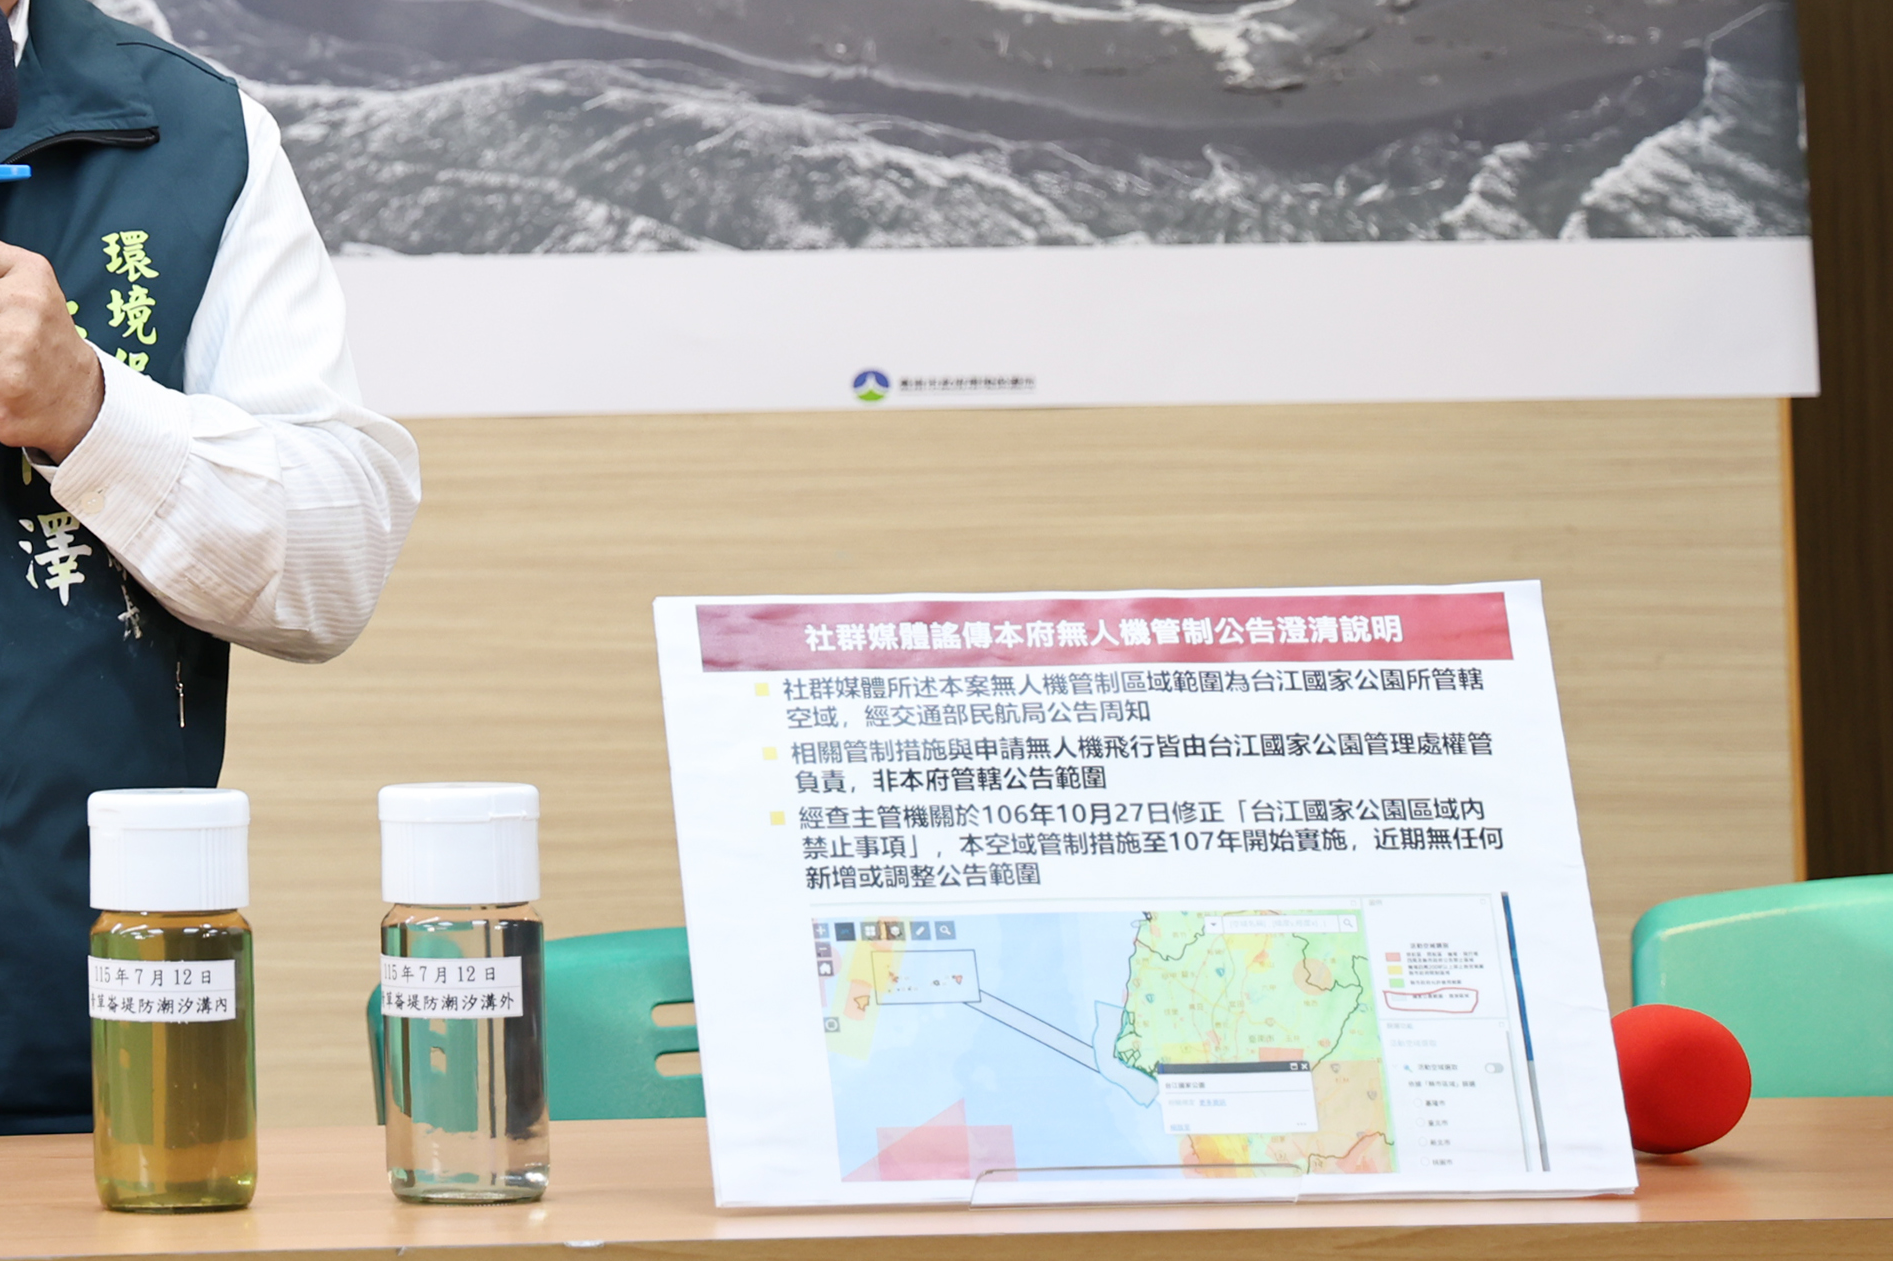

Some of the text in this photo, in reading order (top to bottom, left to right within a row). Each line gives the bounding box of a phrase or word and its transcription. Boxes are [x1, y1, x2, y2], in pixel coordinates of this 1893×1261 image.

[804, 614, 1405, 653] 社群媒體謠傳本府無人機管制公告澄清說明
[782, 668, 1484, 701] 社群媒體所述本案無人機管制區域範圍為台江國家公園所管轄
[790, 731, 1493, 765] 相關管制措施與申請無人機飛行皆由台江國家公園管理處權管
[805, 861, 1042, 891] 新增或調整公告範圍
